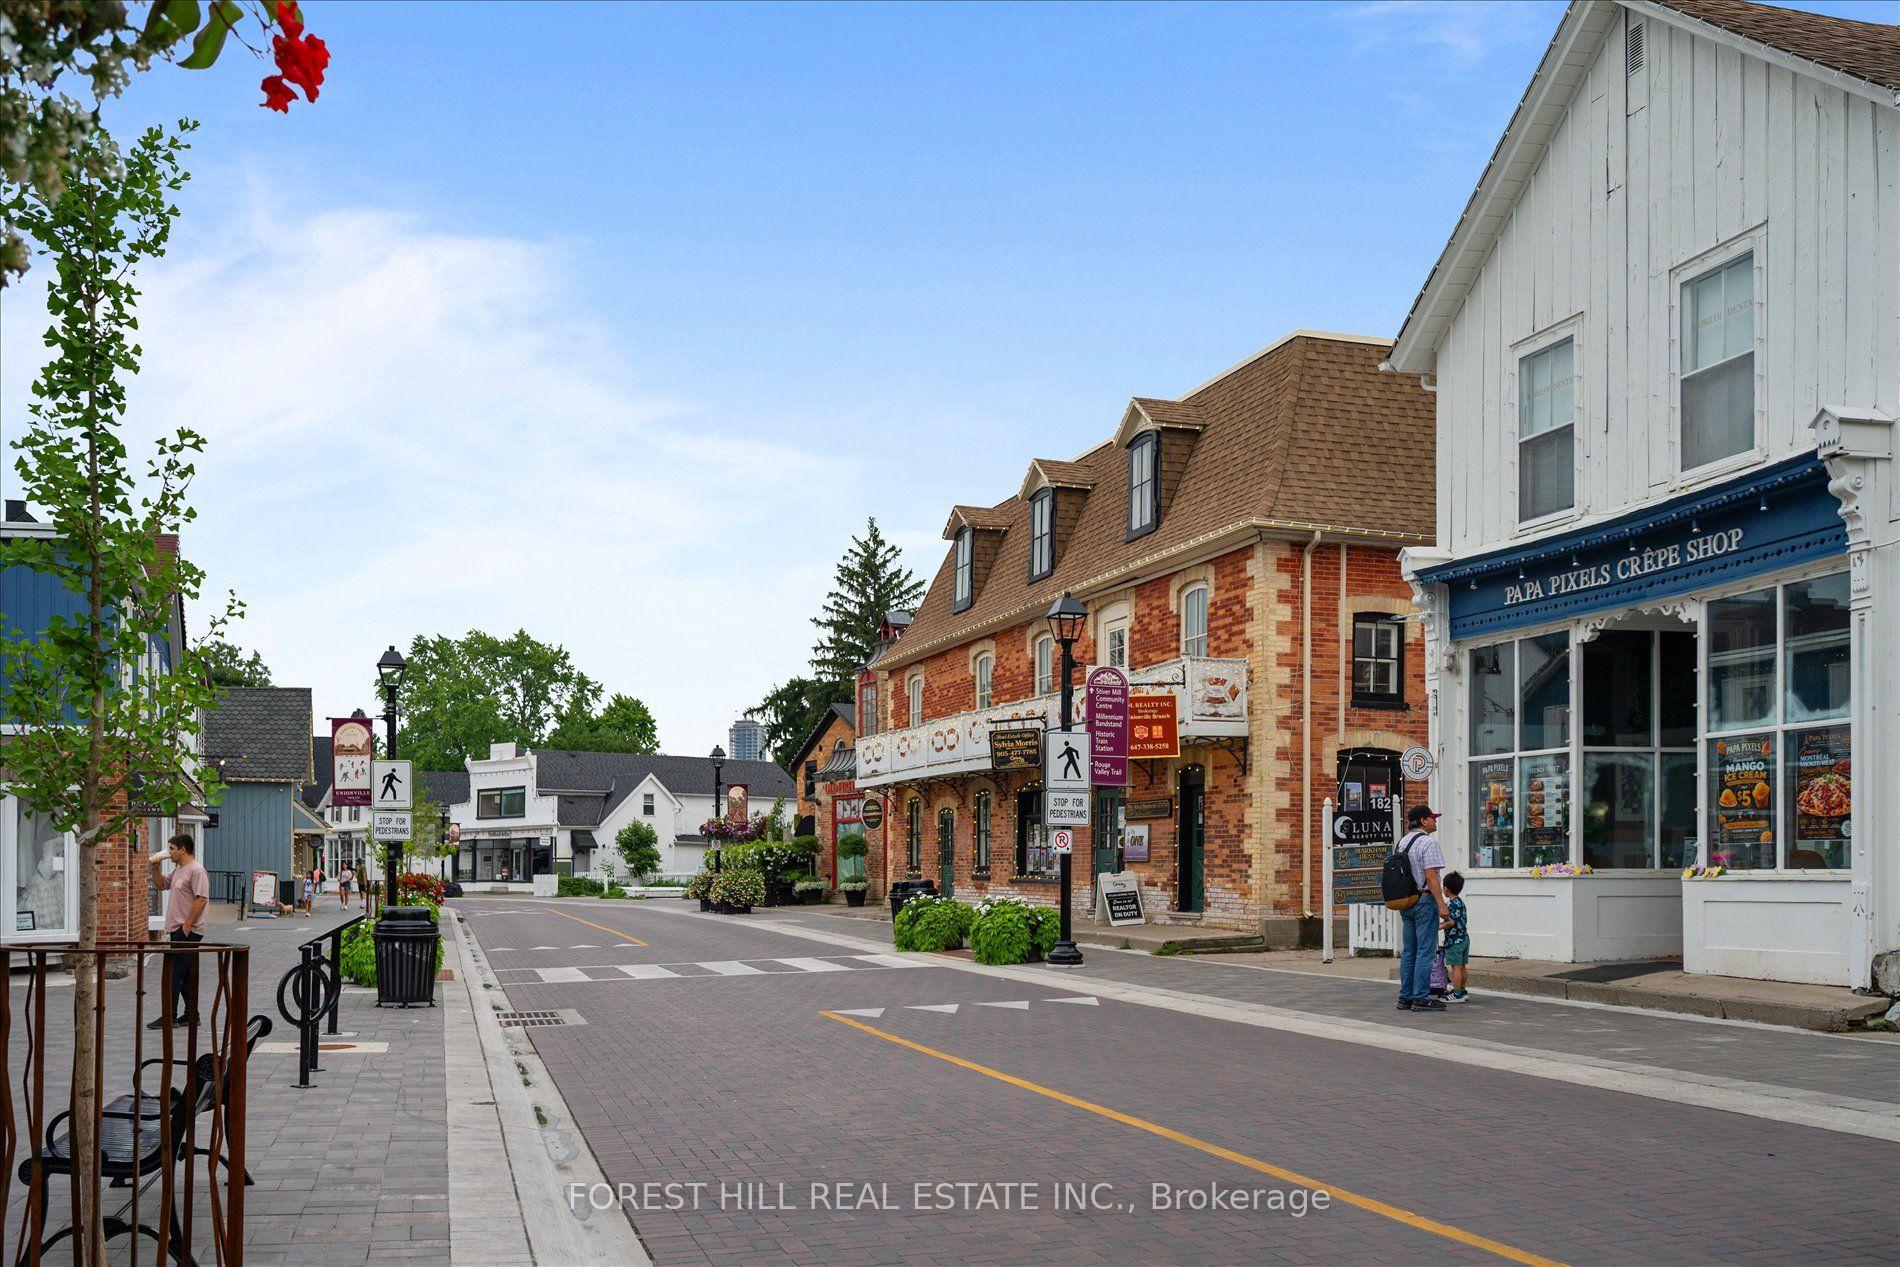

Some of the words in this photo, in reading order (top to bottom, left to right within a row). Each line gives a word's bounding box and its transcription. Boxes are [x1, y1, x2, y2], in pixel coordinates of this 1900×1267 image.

[1504, 580, 1544, 605] PAPA
[1549, 564, 1611, 596] PIXELS
[1617, 546, 1681, 580] CRÊPE
[1687, 528, 1744, 562] SHOP
[1096, 687, 1111, 695] Stiver
[1095, 695, 1125, 704] Community
[1095, 712, 1124, 720] Millennium
[1095, 730, 1115, 738] Historic
[994, 741, 1015, 749] Sylvia
[1726, 745, 1740, 754] PAPA
[1741, 743, 1761, 752] PIXELS
[1095, 760, 1111, 768] Rouge
[1726, 761, 1765, 773] MANGO
[1095, 768, 1110, 776] Valley
[1724, 773, 1737, 782] ICE
[1738, 771, 1767, 780] CREAM
[1053, 798, 1069, 807] STOP
[1072, 798, 1084, 807] FOR
[1737, 789, 1752, 808] $5
[1370, 798, 1391, 809] 182
[1049, 809, 1087, 819] PEDESTRIANS
[375, 827, 409, 835] PEDESTRIANS
[1352, 821, 1392, 833] LUNA
[1130, 835, 1145, 846] ONE
